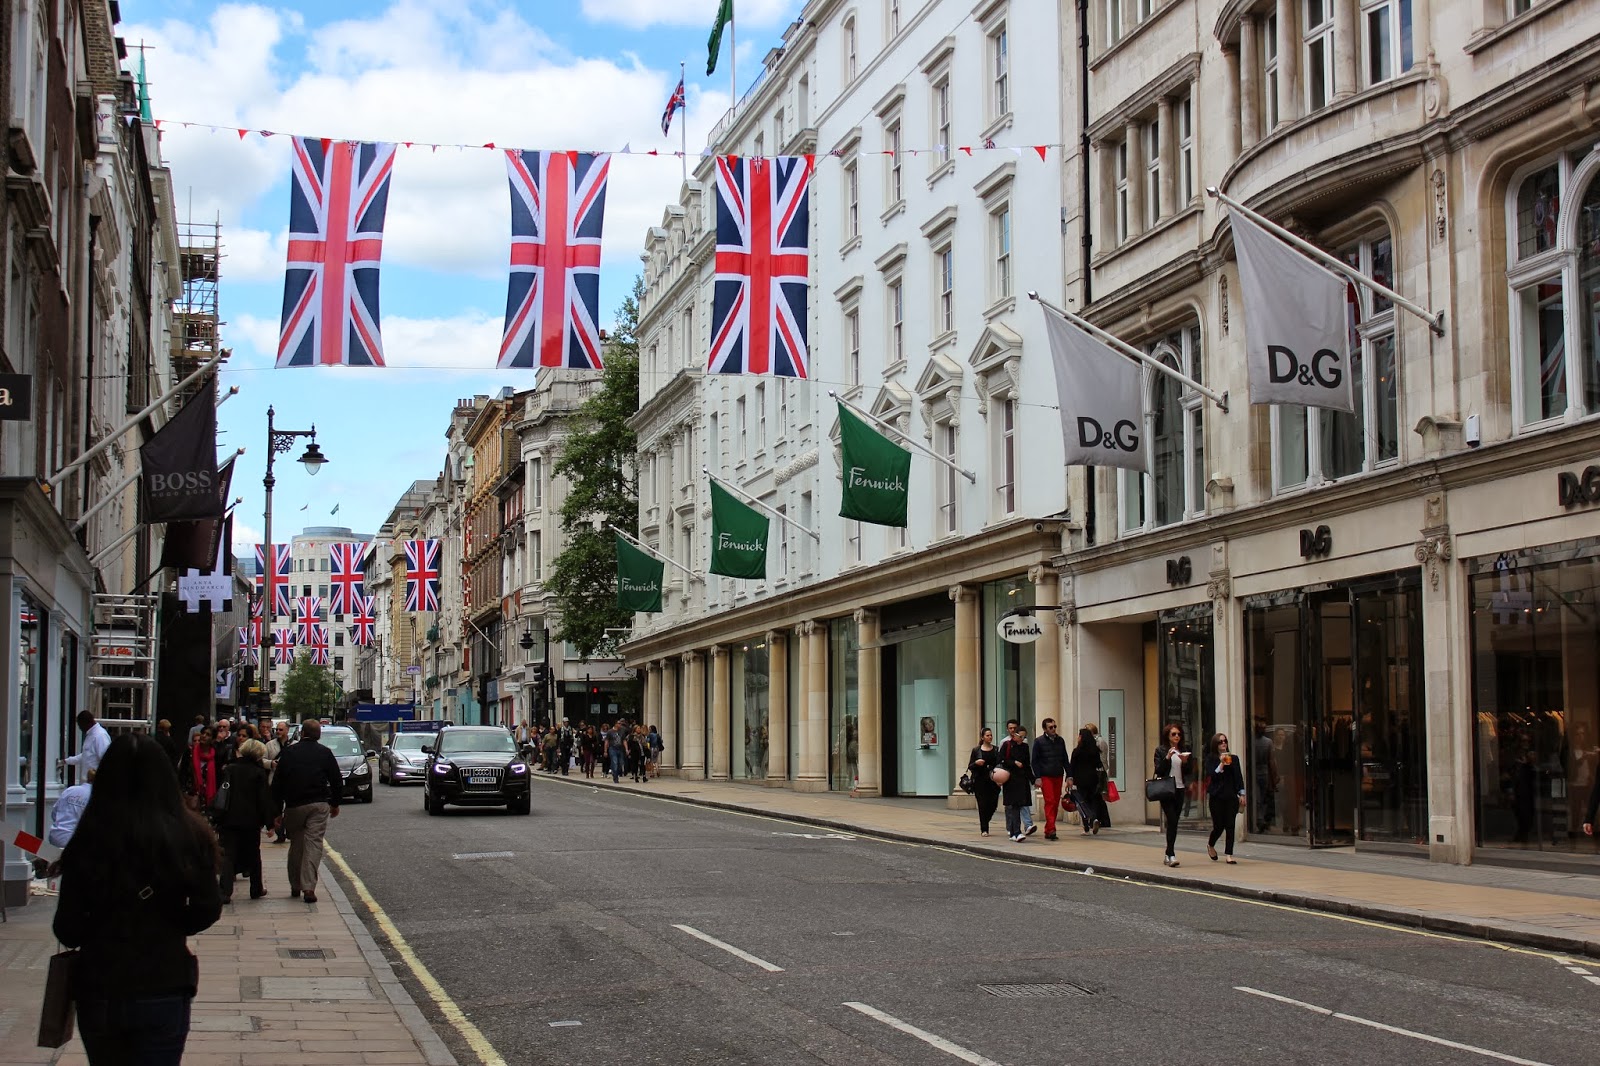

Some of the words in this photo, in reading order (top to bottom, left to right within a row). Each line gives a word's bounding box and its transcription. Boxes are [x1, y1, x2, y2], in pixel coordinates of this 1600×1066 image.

[1267, 345, 1342, 389] D&G
[1077, 416, 1139, 452] D&G
[150, 470, 212, 491] BOSS
[849, 466, 905, 491] Fenwick
[718, 532, 764, 551] Fenwick
[621, 577, 658, 591] Fenwick
[1003, 621, 1042, 639] Fenwick
